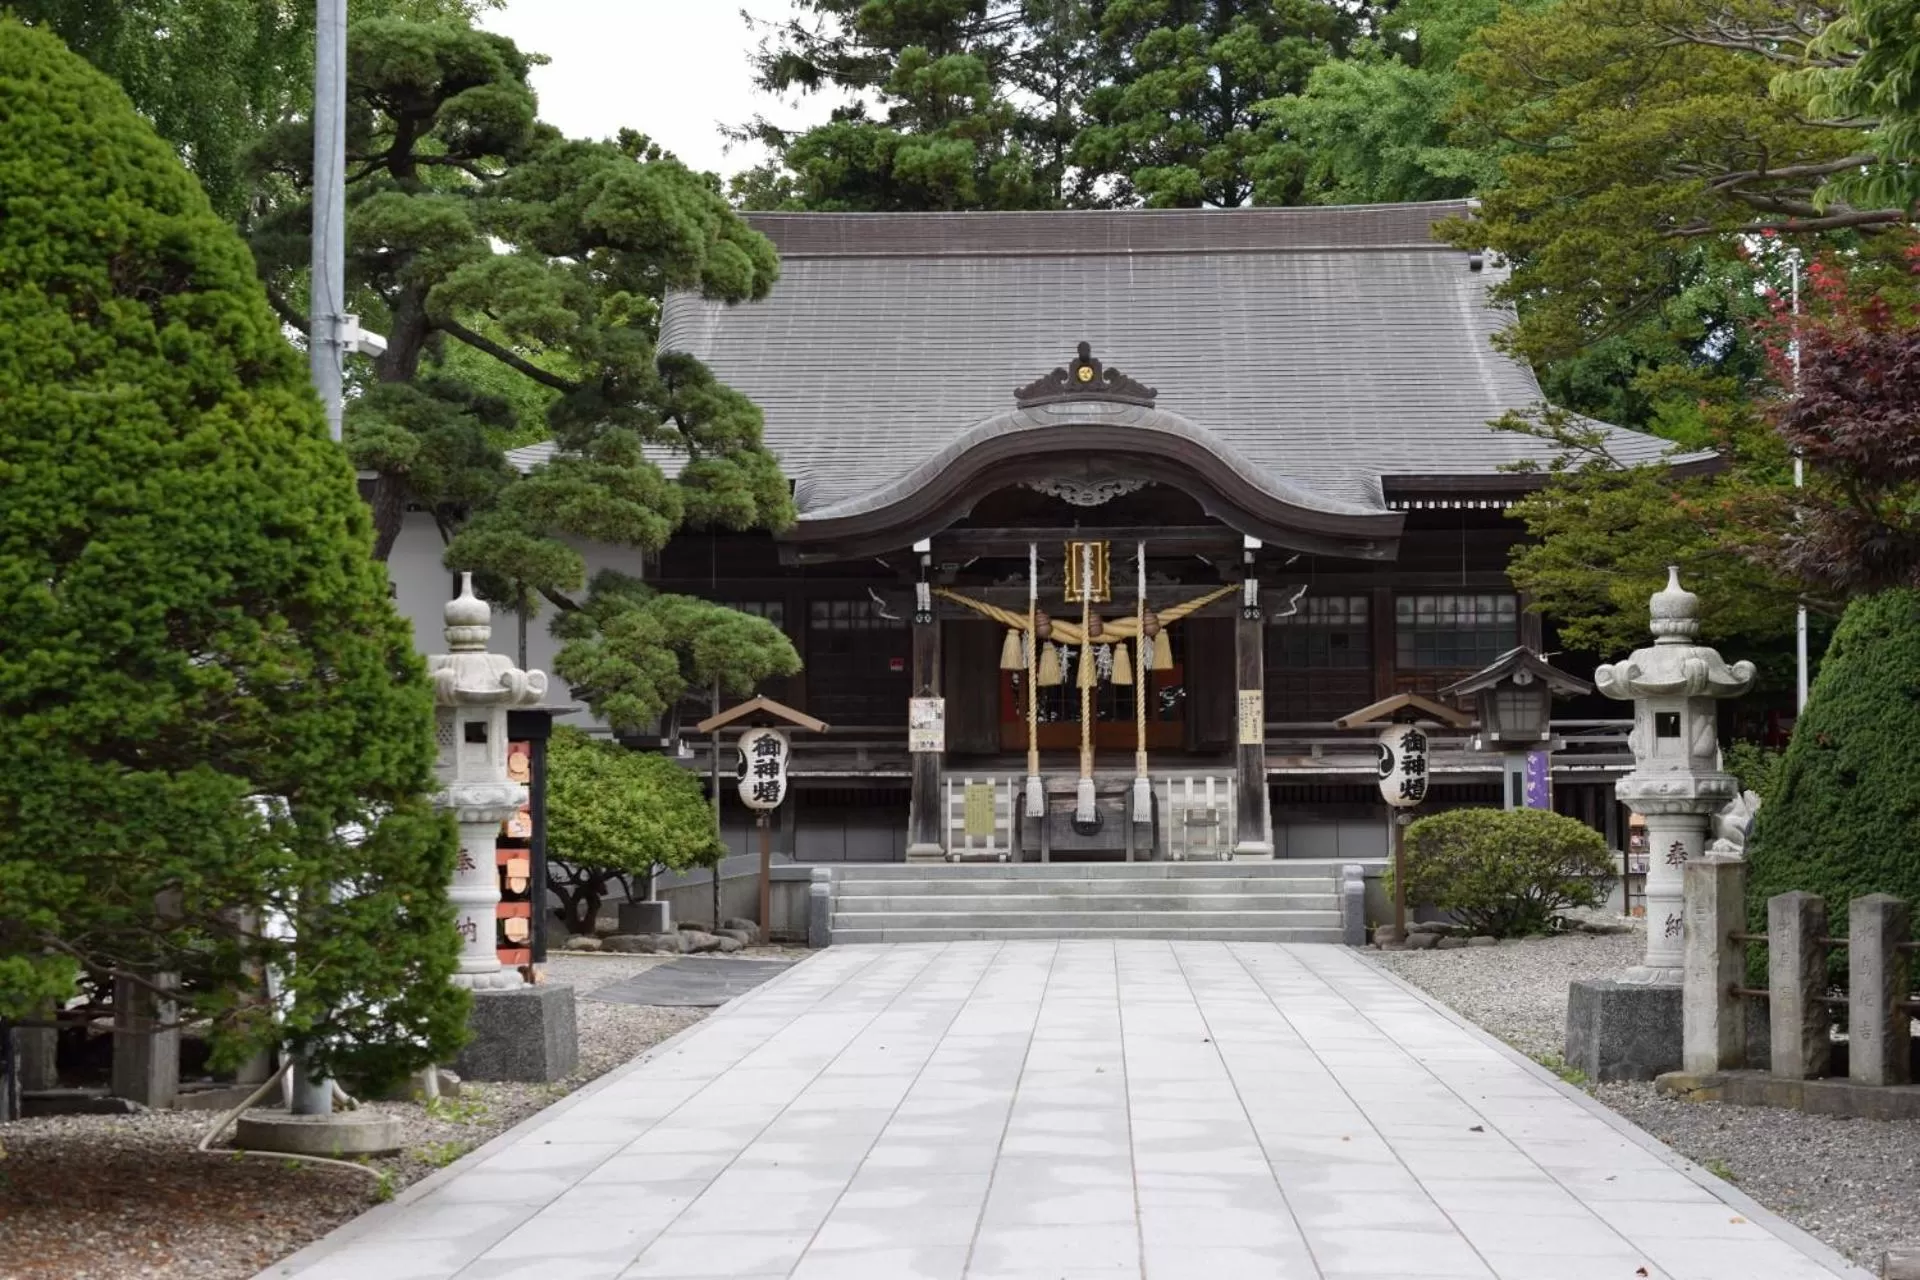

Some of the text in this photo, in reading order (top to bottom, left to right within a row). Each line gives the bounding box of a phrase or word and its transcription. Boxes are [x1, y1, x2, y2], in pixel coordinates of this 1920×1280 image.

[752, 733, 781, 803] 御神燈
[1399, 729, 1427, 801] 御神燈
[456, 847, 477, 943] 奉納
[1665, 840, 1689, 938] 奉納
